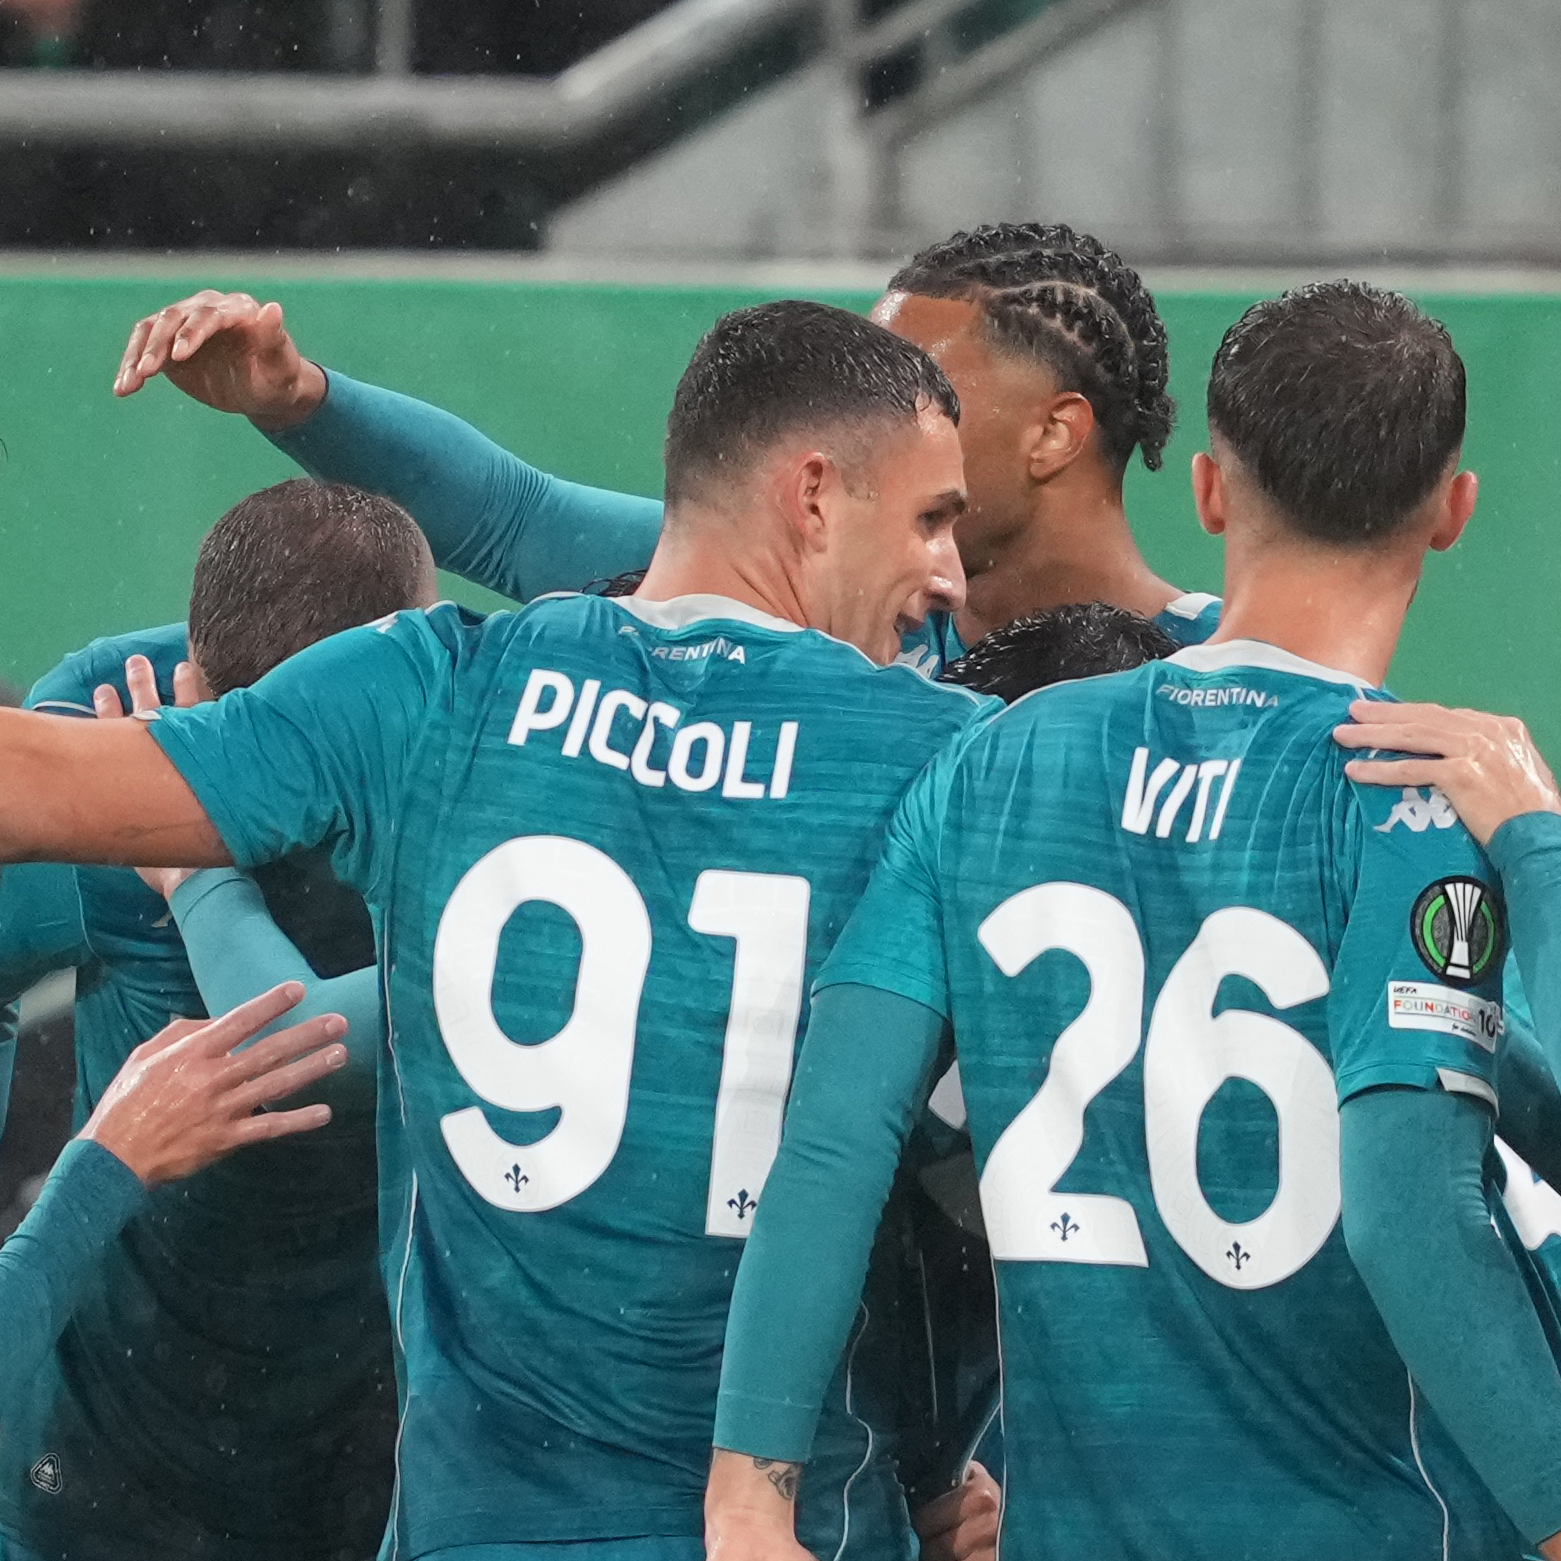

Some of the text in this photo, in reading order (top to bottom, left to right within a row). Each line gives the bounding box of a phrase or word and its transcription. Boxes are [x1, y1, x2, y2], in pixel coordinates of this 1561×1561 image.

[507, 668, 798, 800] PICCOLI
[1155, 683, 1279, 708] FIORENTINA
[1121, 746, 1242, 843] VITI
[433, 834, 811, 1237] 91
[977, 881, 1341, 1290] 26
